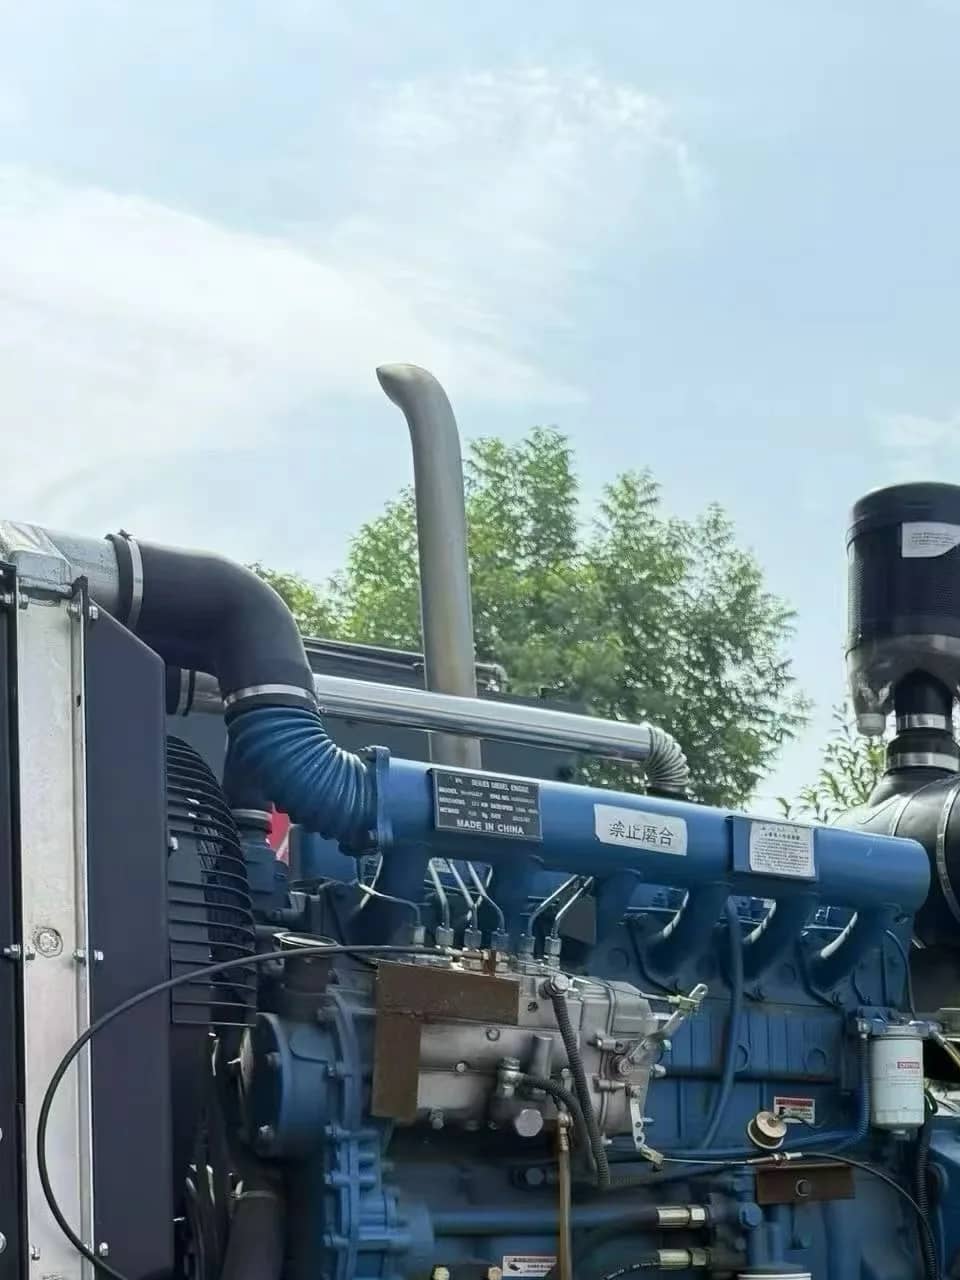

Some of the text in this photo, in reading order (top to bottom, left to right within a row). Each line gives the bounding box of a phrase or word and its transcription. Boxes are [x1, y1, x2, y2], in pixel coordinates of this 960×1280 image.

[456, 818, 525, 835] MADE IN CHINA
